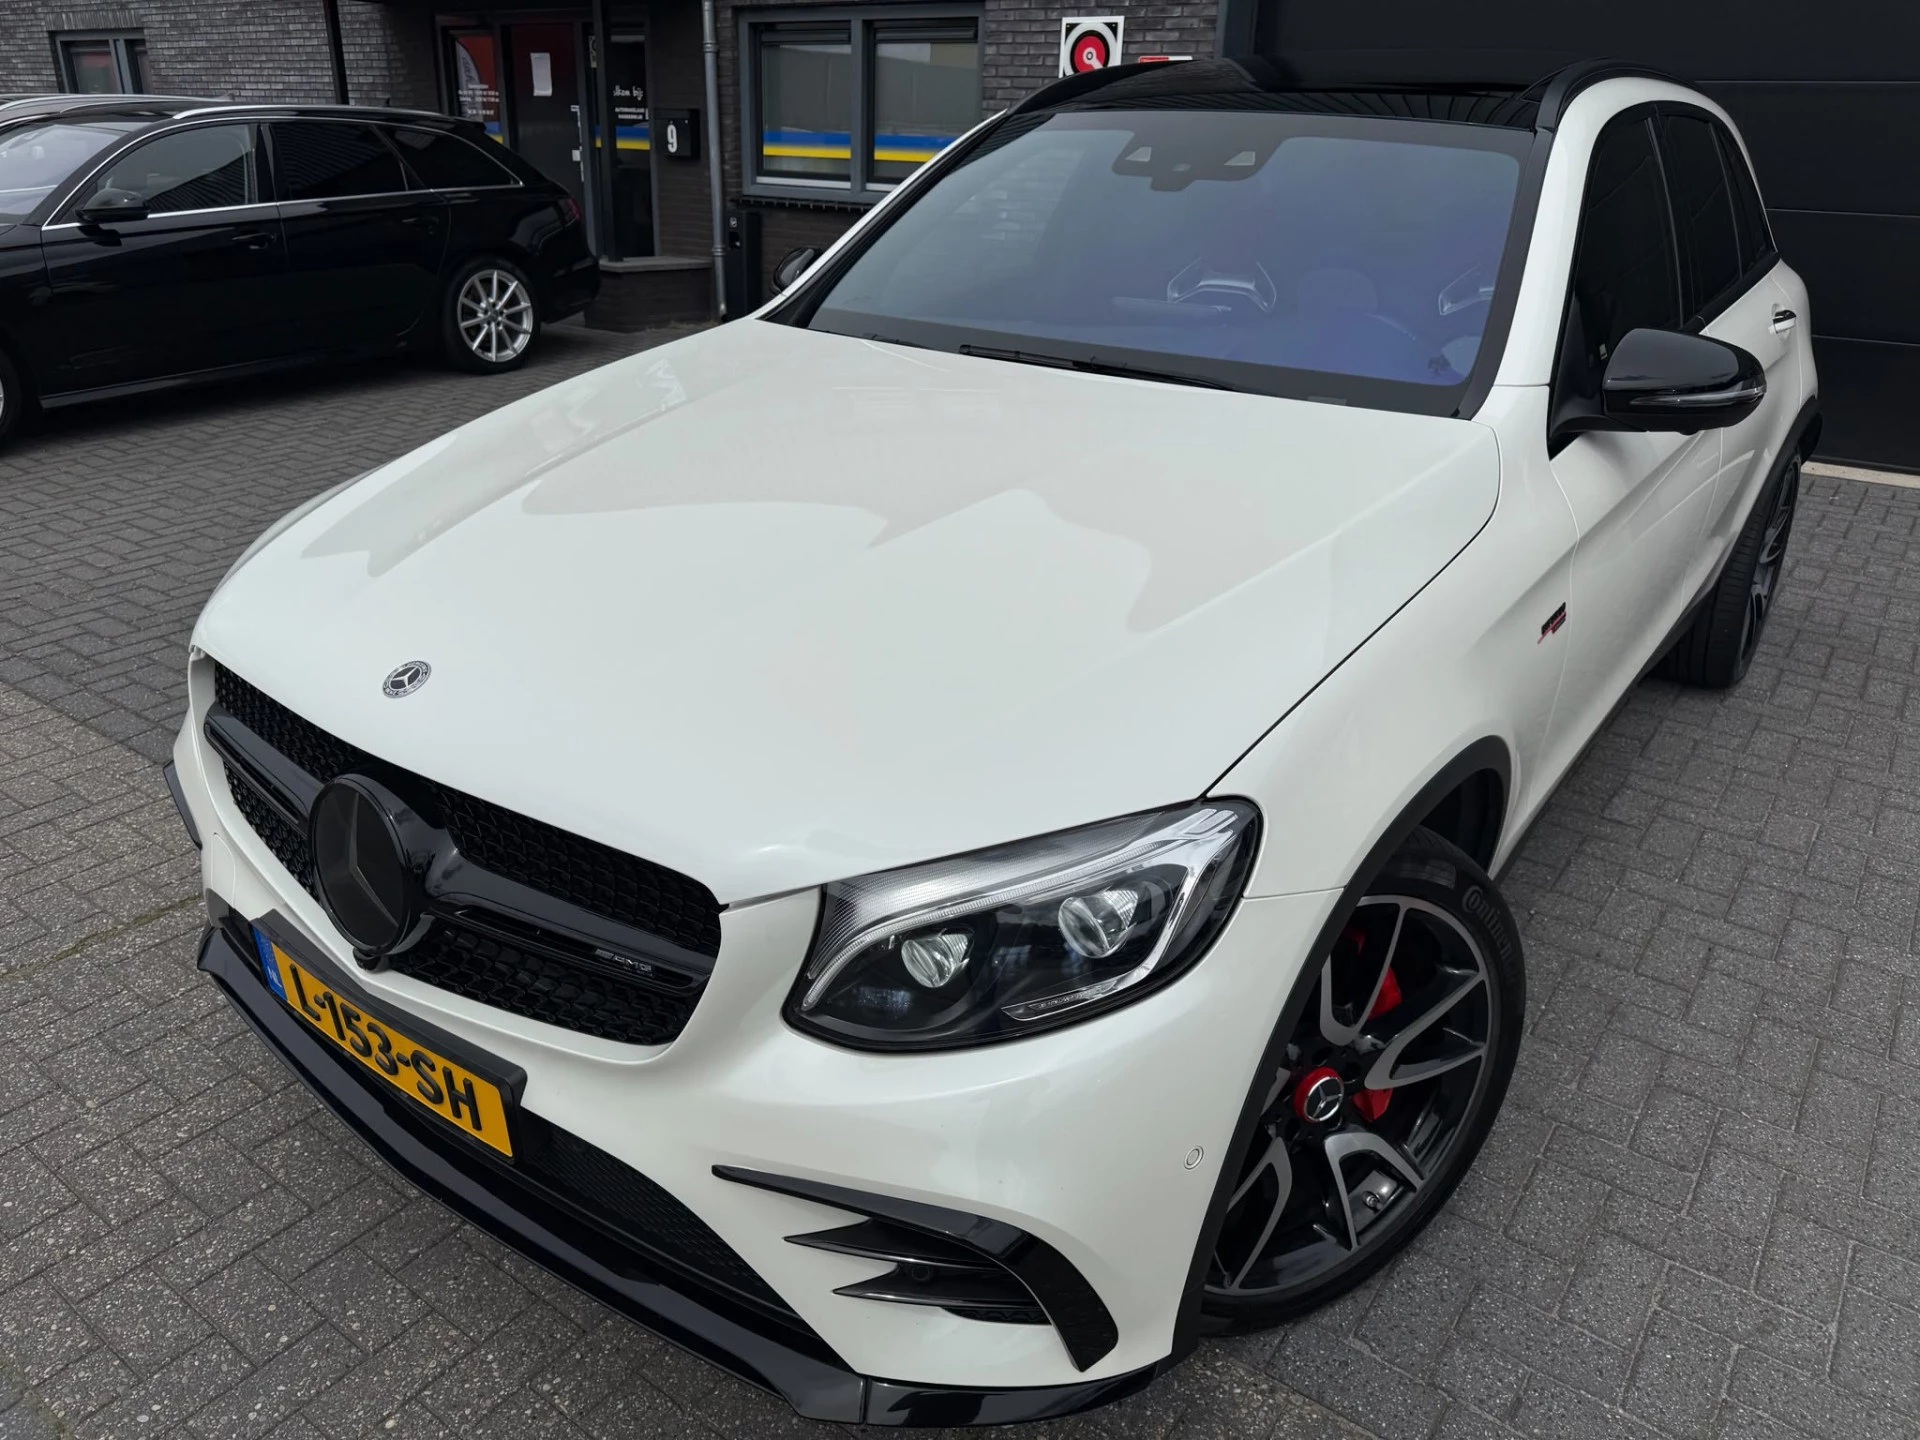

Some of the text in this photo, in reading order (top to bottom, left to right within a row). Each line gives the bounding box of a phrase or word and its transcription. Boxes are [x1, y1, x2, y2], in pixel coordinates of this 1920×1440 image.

[667, 124, 678, 153] 9
[267, 965, 283, 989] NL
[290, 963, 482, 1132] L-153-SH
